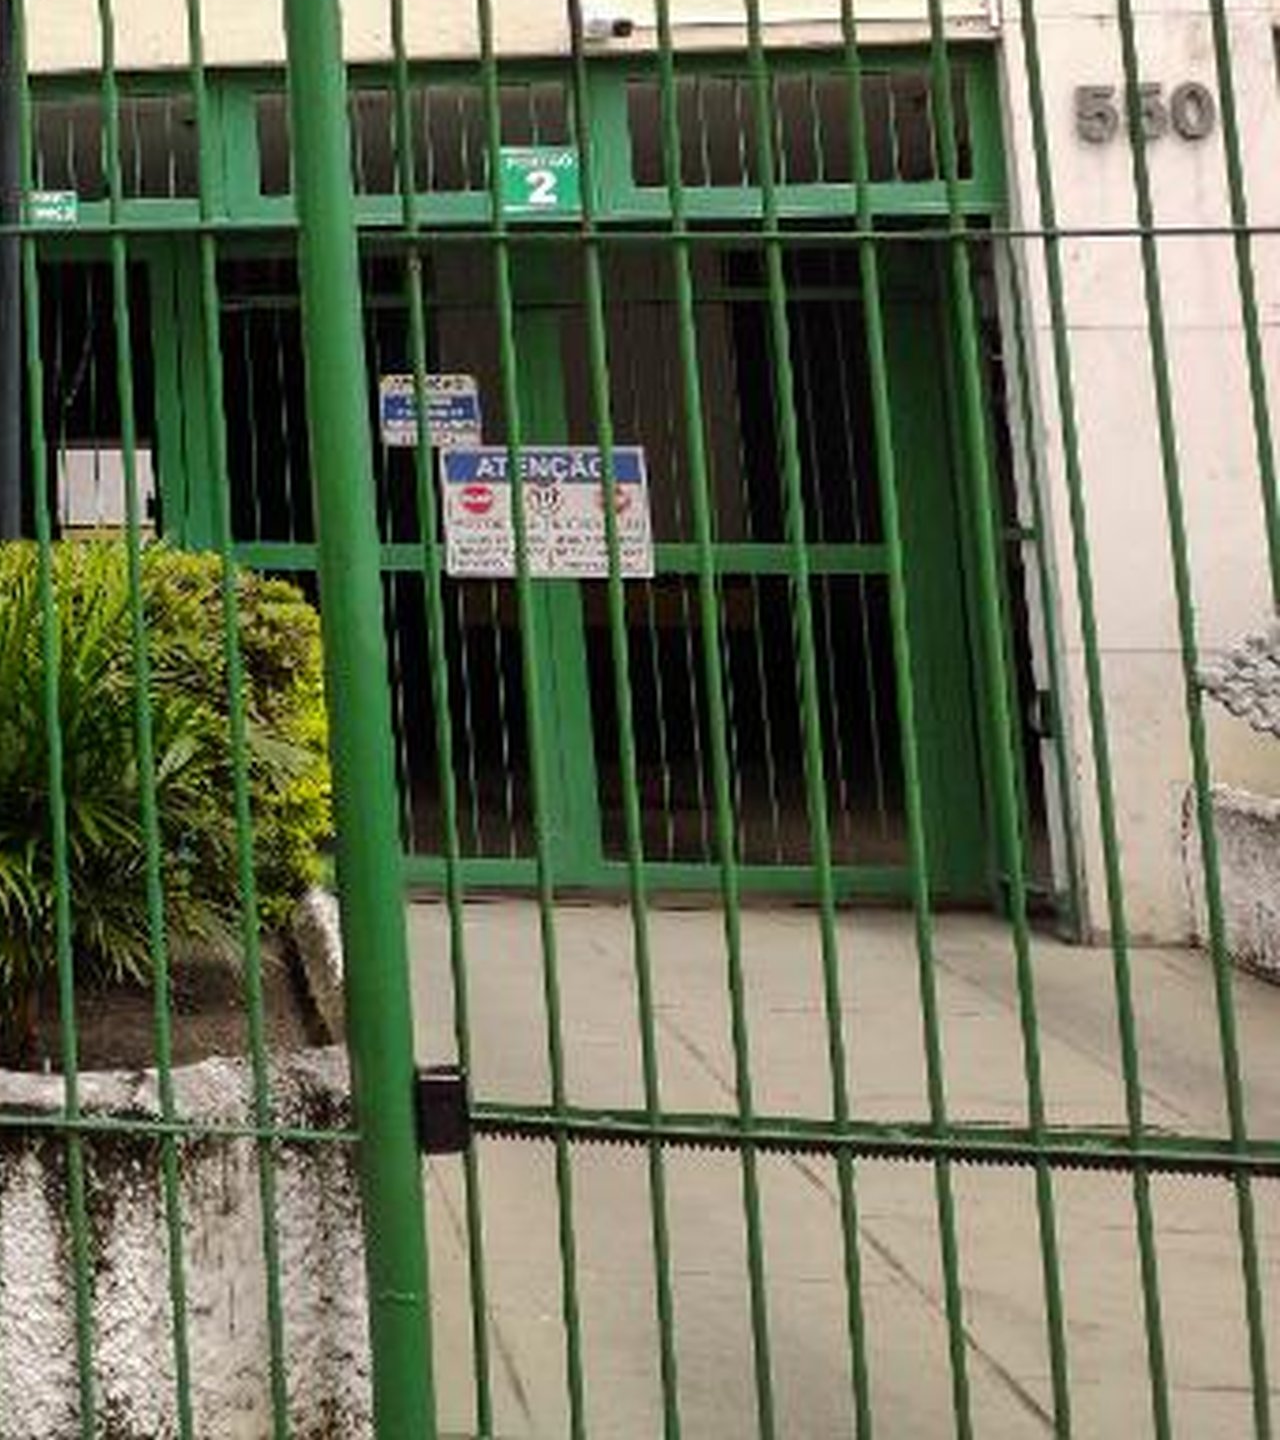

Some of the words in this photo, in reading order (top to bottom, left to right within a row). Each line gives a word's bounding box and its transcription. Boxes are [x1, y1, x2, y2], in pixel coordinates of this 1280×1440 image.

[1074, 82, 1216, 145] 550
[525, 170, 558, 204] 2
[475, 452, 609, 482] ATENÇÃO
